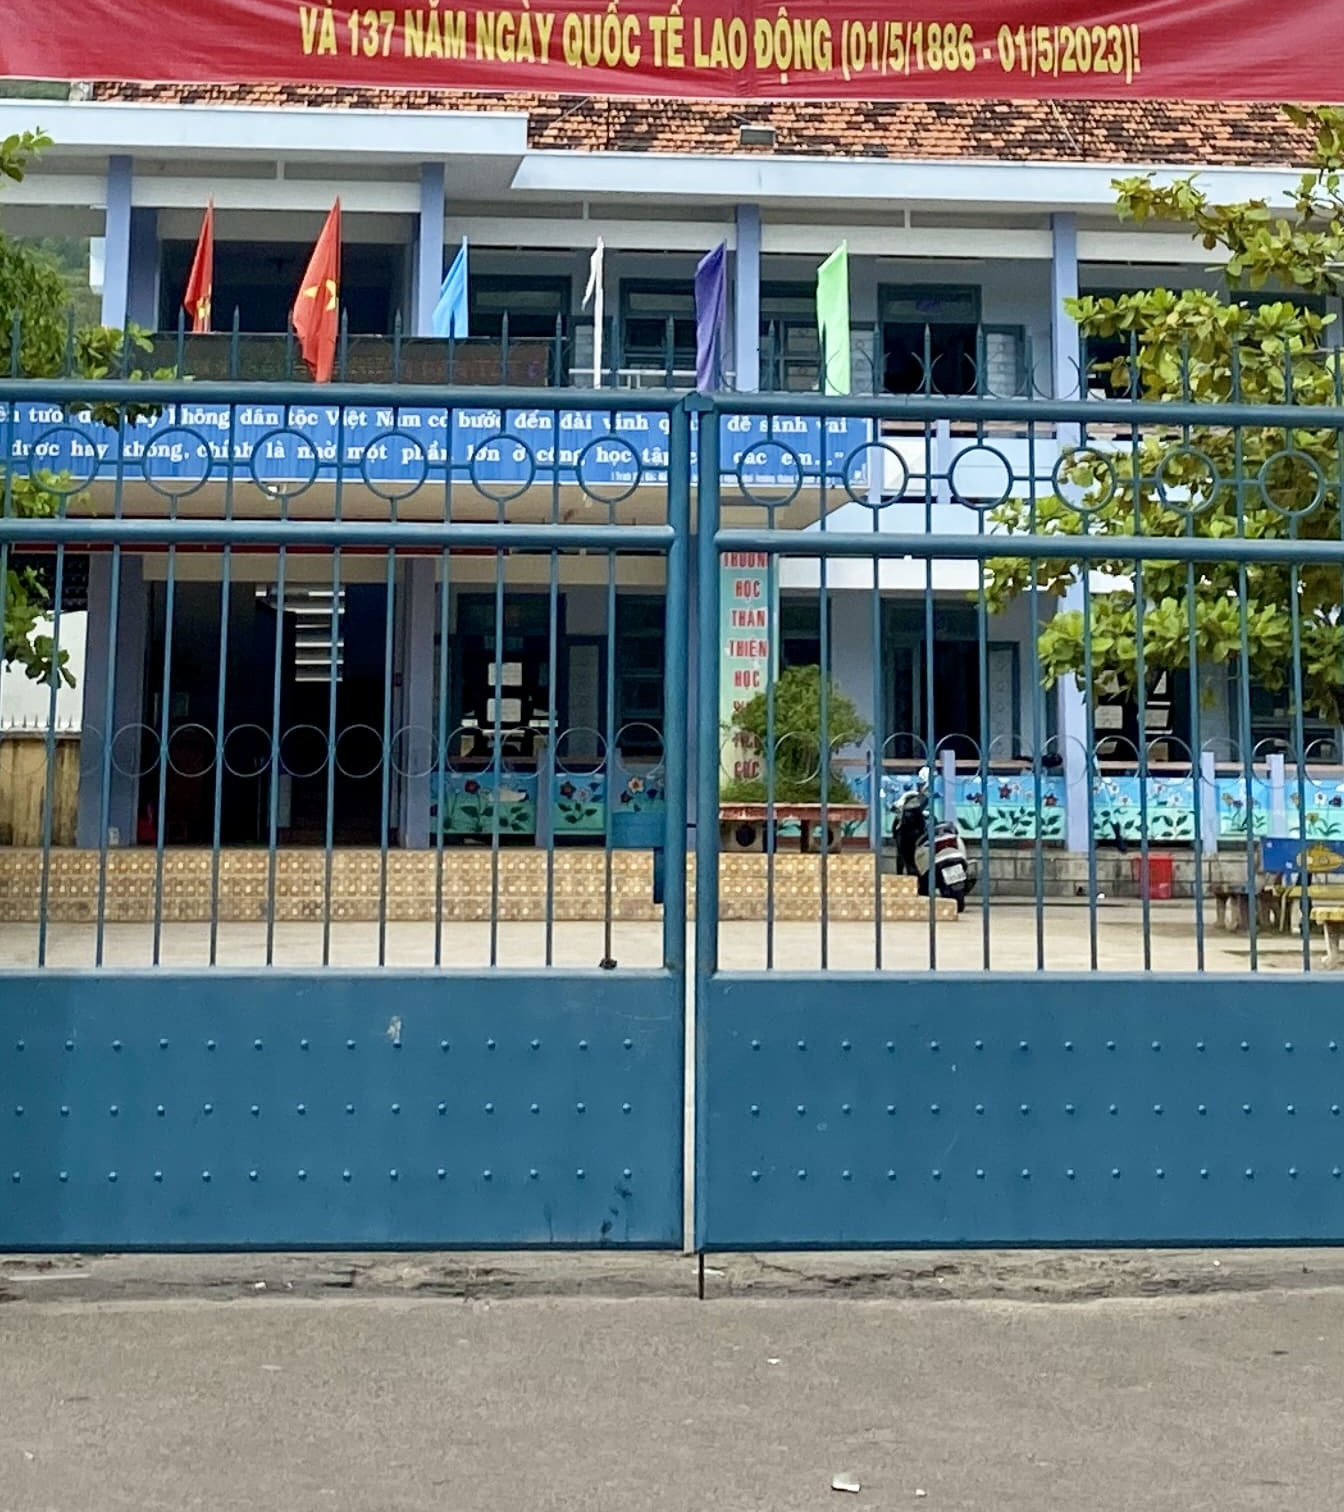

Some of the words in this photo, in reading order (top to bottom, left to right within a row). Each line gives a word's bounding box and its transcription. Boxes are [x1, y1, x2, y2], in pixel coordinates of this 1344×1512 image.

[349, 9, 393, 58] 137
[693, 18, 748, 70] LAO
[753, 6, 833, 85] ĐỘNG
[839, 18, 976, 83] (01/5/1886
[28, 406, 68, 424] tươ
